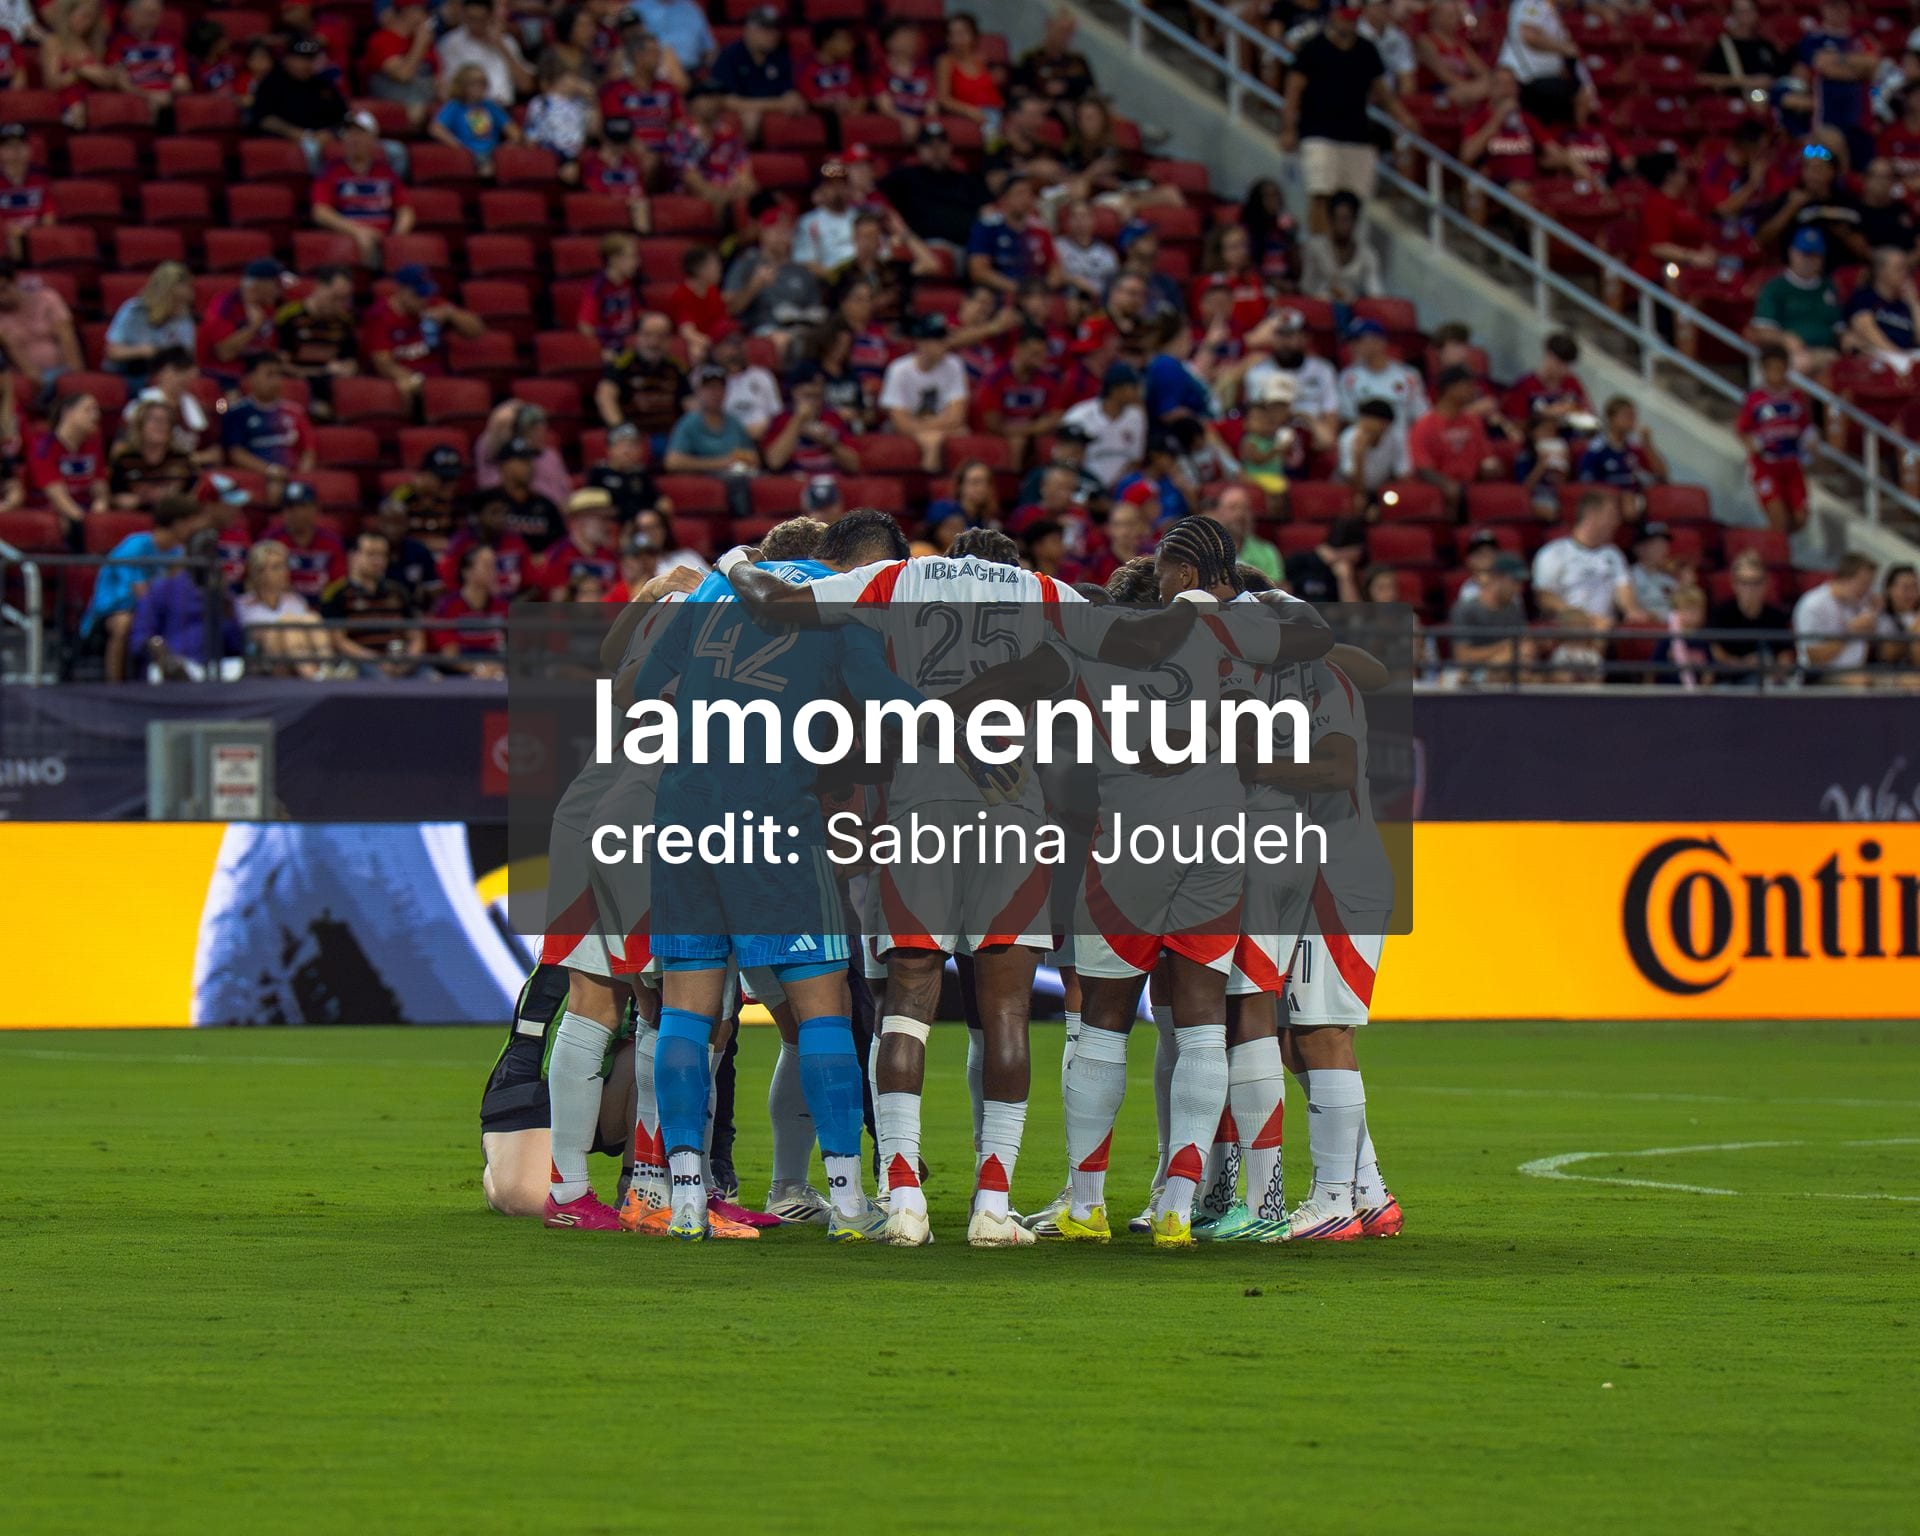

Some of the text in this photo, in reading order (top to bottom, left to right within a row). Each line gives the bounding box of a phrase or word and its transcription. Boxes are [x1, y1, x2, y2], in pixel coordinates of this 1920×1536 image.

[924, 561, 1019, 583] IBEAGHA
[693, 594, 799, 693] 42
[914, 600, 1022, 688] 25
[673, 1174, 701, 1187] PRO
